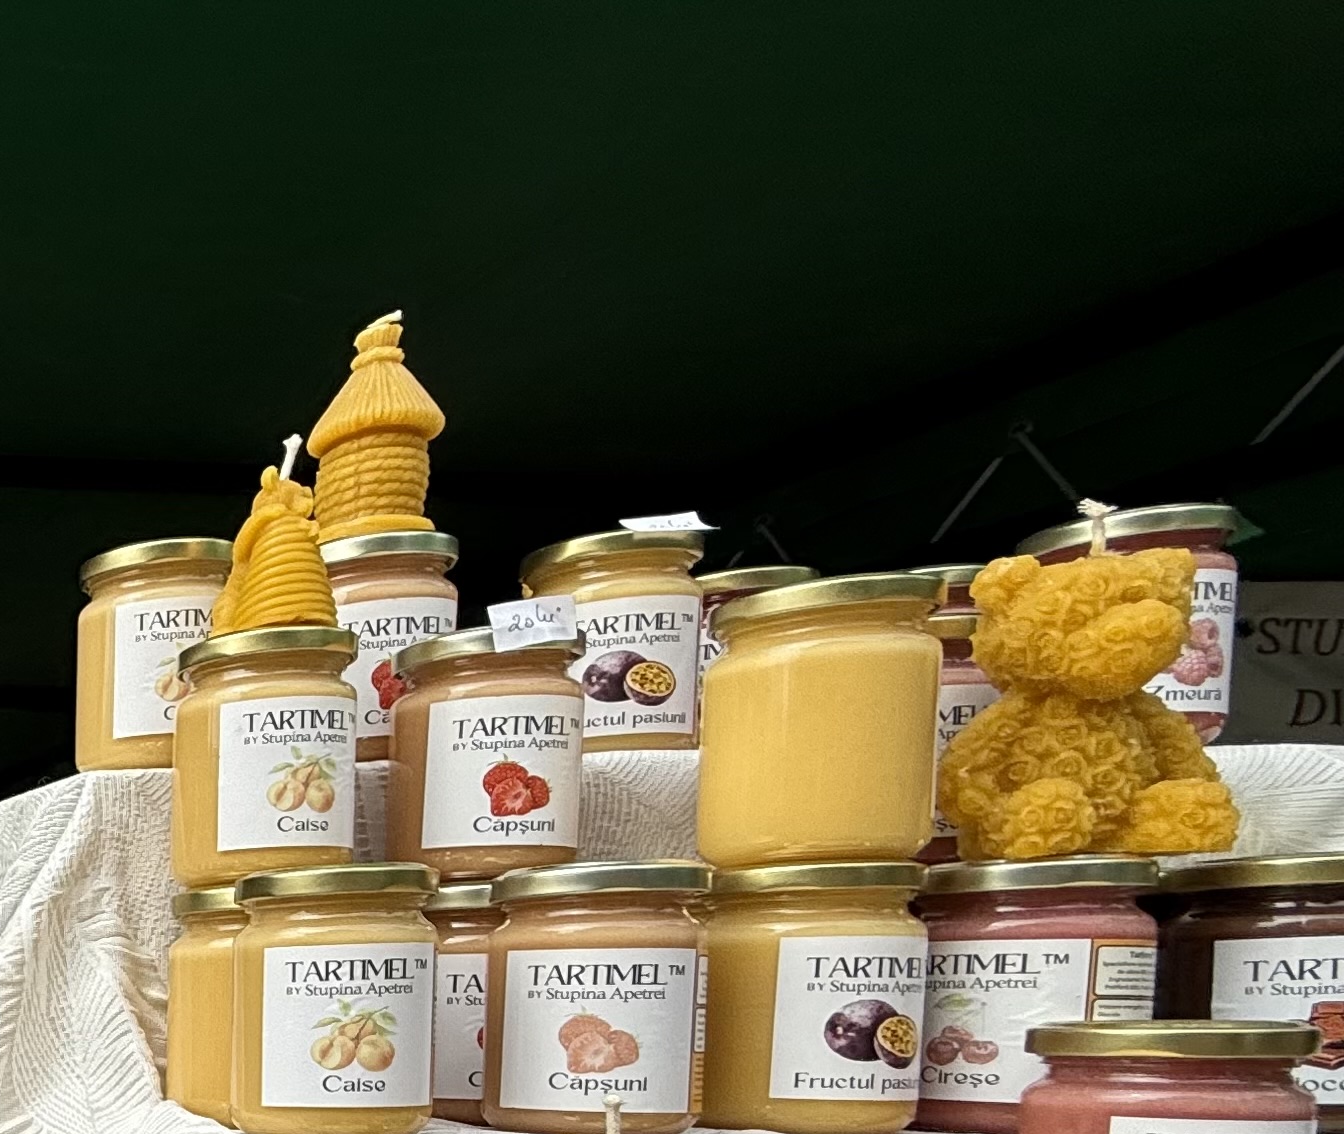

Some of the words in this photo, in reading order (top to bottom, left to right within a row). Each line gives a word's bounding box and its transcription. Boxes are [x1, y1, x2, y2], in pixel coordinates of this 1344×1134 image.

[134, 608, 213, 631] TARTIM
[1256, 617, 1344, 656] STU
[583, 711, 626, 730] uctul
[261, 732, 311, 746] Stupina
[470, 738, 525, 752] Stupina
[276, 815, 330, 833] Caise
[528, 962, 686, 986] TARTIMEL™
[1244, 958, 1344, 982] TART
[286, 986, 302, 995] BY
[304, 982, 363, 999] Stupina
[806, 981, 826, 992] BY
[829, 979, 889, 997] Stupina
[972, 976, 1039, 992] Apetrei
[1244, 986, 1265, 995] BY
[528, 989, 544, 999] BY
[545, 986, 607, 1004] Stupina
[609, 985, 667, 1002] Apetrei
[321, 1073, 387, 1093] Caise
[794, 1071, 875, 1090] Fructul
